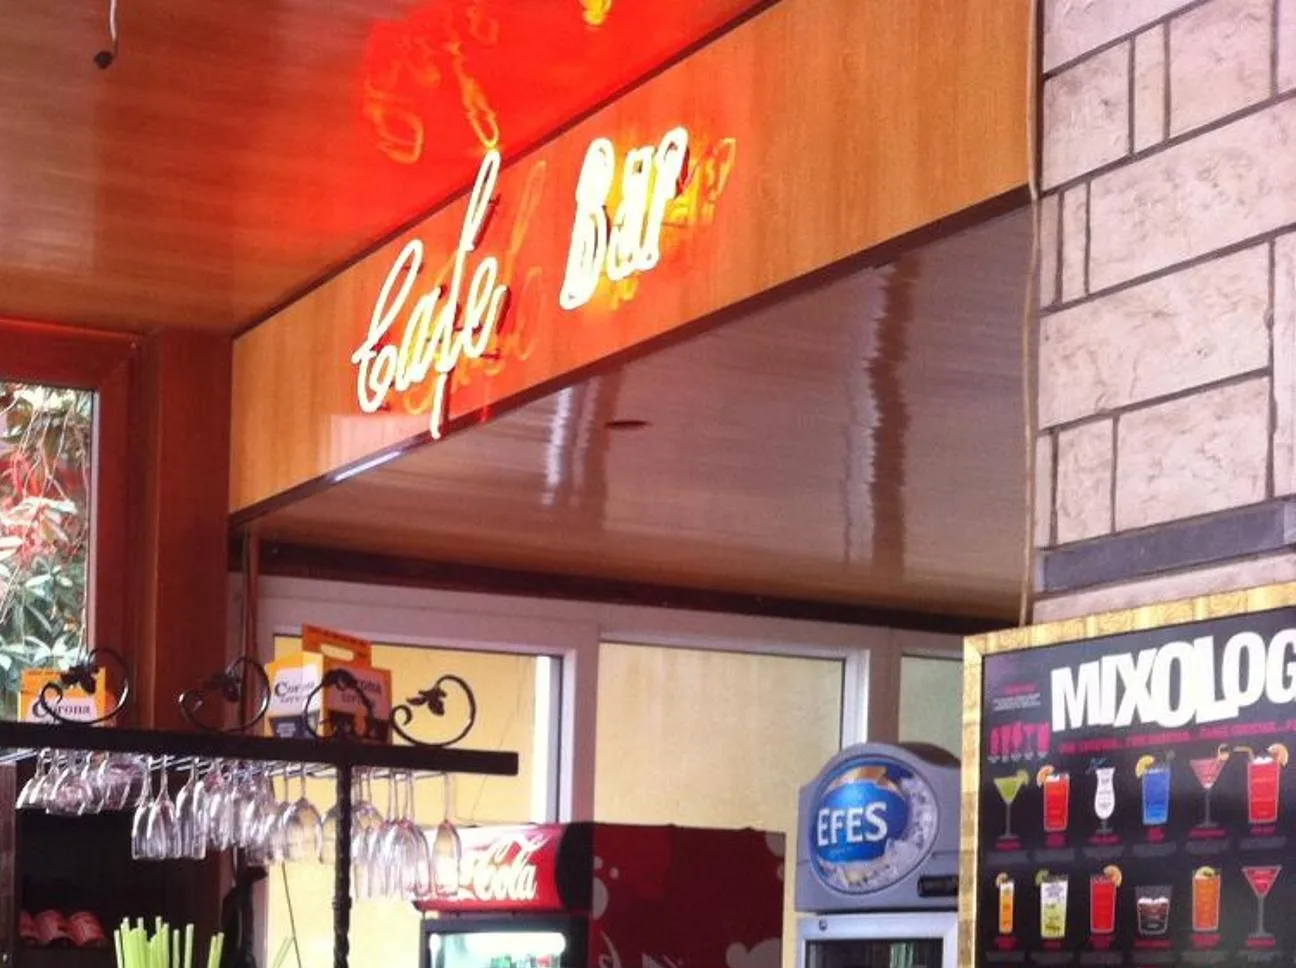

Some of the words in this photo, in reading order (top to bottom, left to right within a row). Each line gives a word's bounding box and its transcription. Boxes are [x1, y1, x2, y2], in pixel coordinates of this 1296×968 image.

[559, 126, 689, 311] Bar
[1050, 627, 1296, 732] MIXOLOG
[817, 801, 888, 847] EFES
